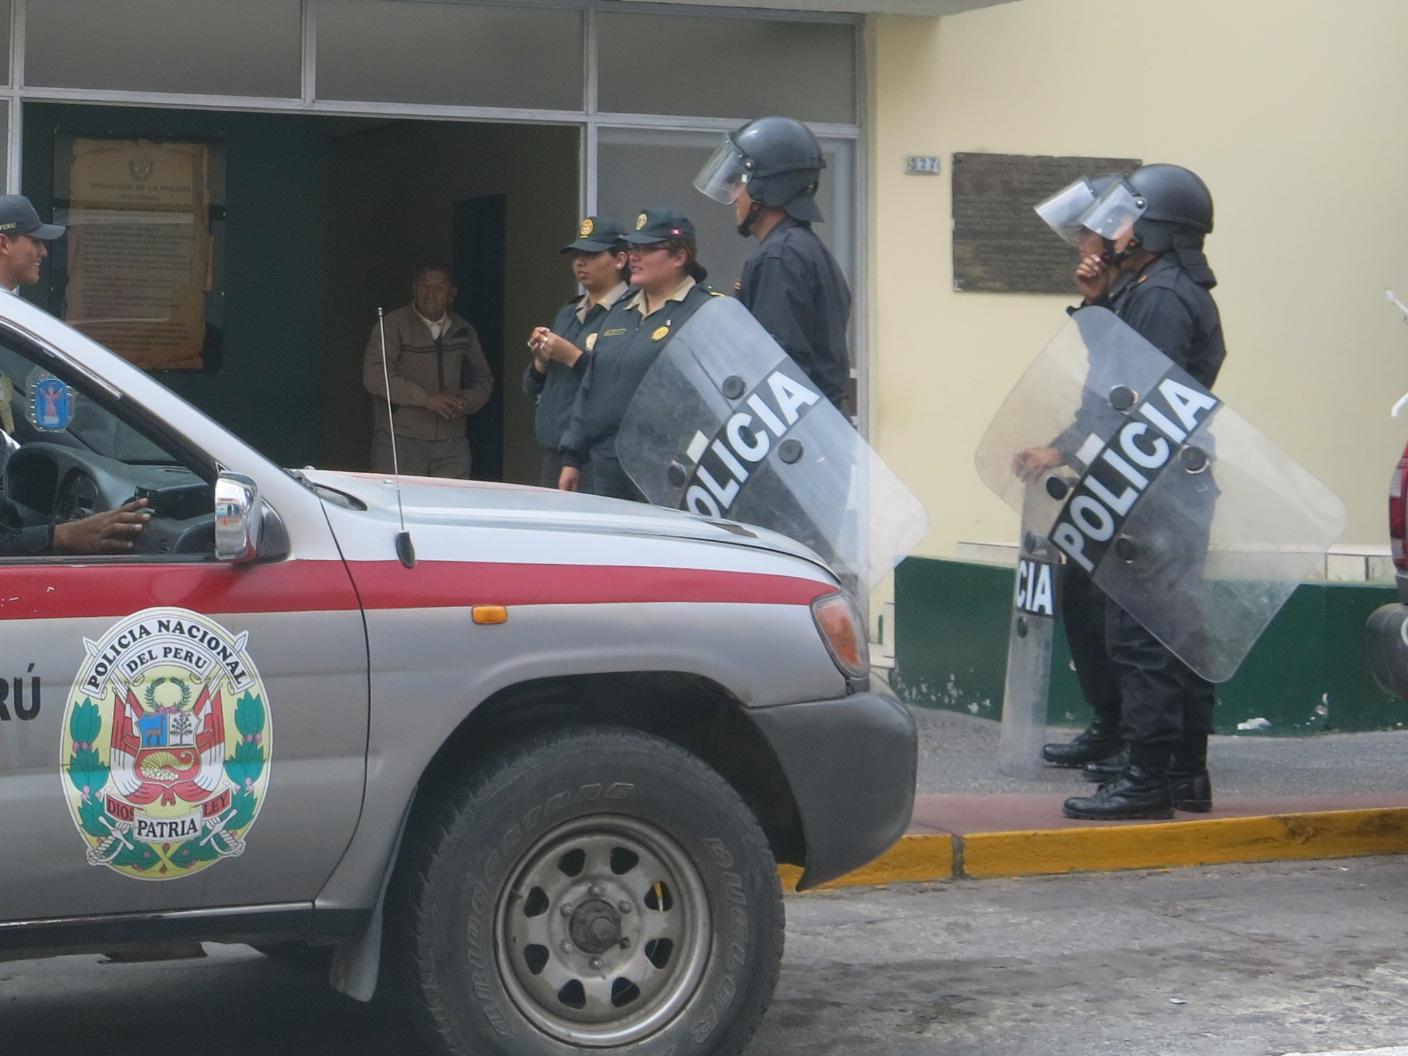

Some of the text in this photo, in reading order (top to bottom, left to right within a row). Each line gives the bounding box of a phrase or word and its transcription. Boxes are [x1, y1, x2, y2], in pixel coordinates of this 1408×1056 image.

[686, 370, 820, 522] OLICIA
[1051, 377, 1218, 573] POLICIA
[87, 619, 247, 689] POLICIA NACIONAL
[126, 646, 207, 674] DEL PERU
[137, 817, 199, 838] PATRIA
[203, 795, 229, 818] LEY
